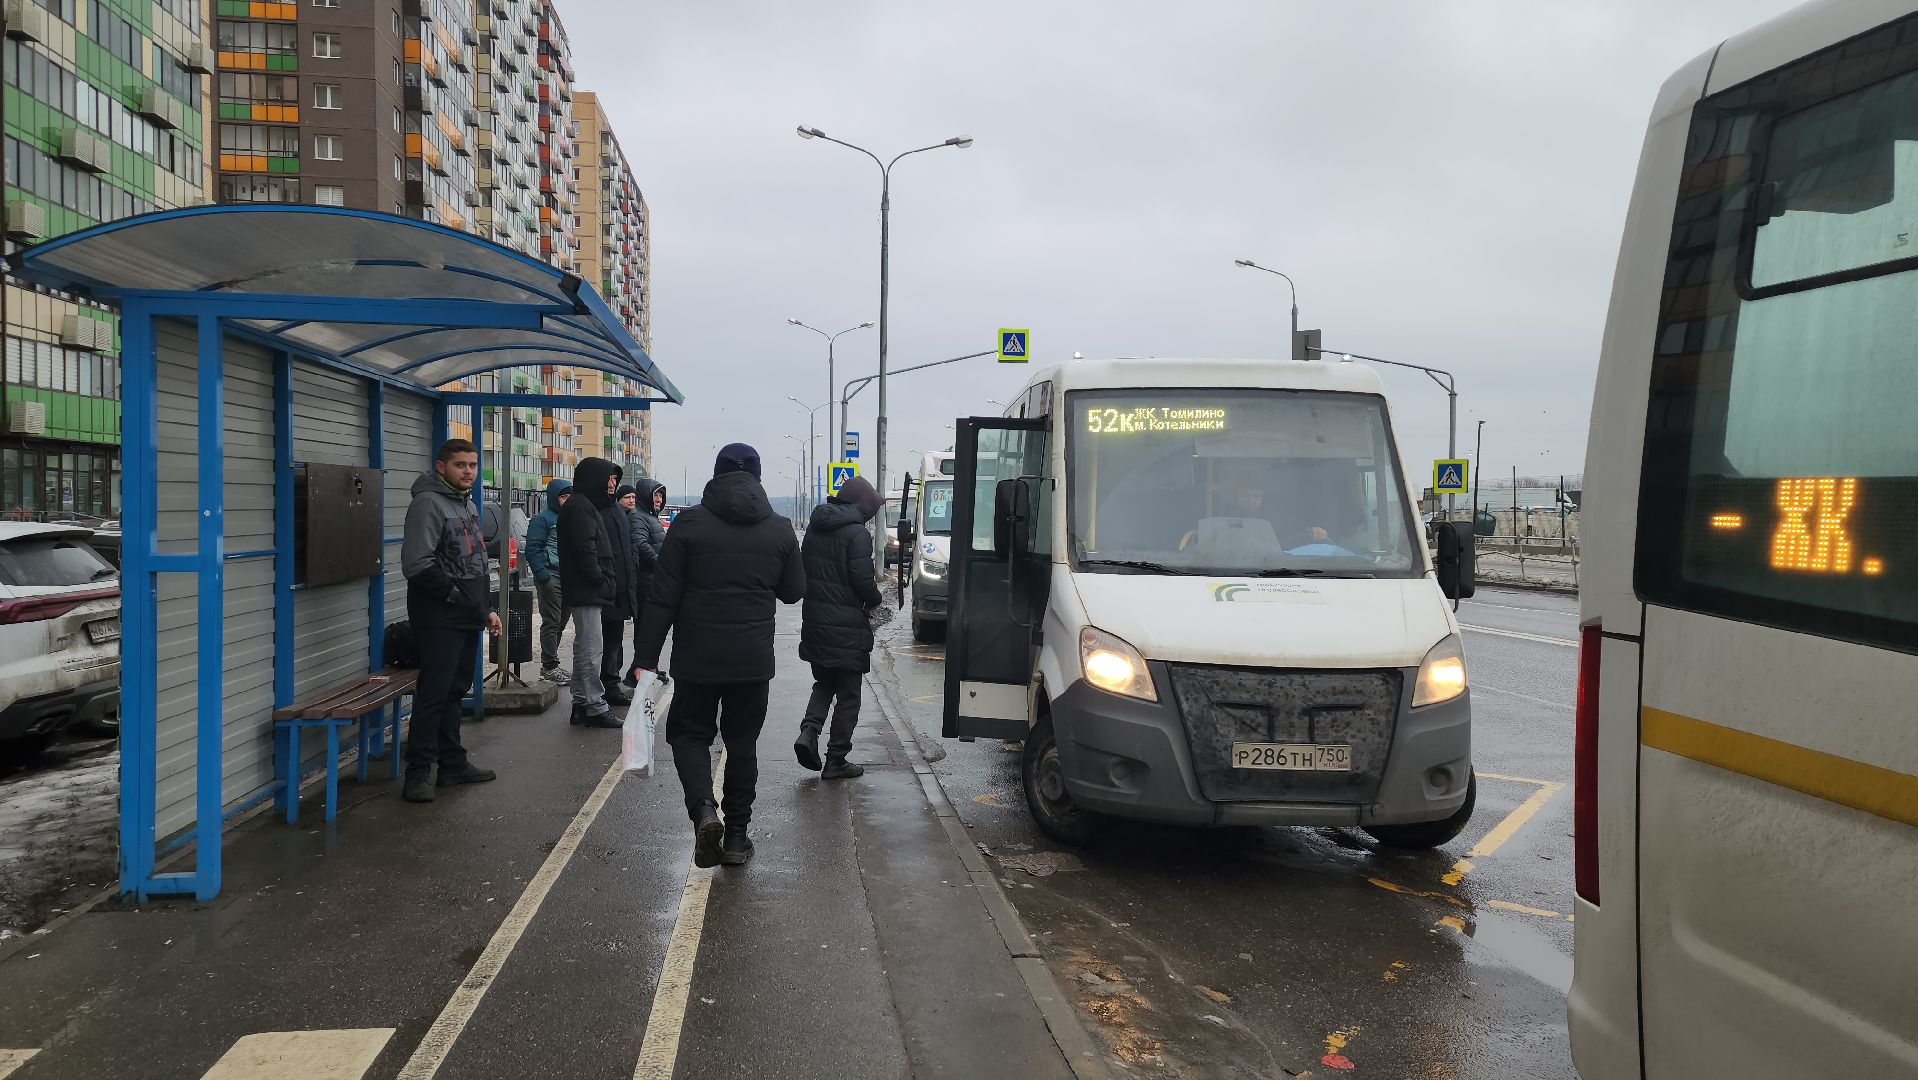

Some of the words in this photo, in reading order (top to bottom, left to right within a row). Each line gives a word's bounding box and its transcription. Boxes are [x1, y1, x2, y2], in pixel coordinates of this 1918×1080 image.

[1135, 407, 1156, 419] ЖК
[1161, 407, 1225, 419] Томилино
[1134, 420, 1147, 431] м.
[1149, 419, 1224, 431] Котельники
[1317, 747, 1345, 763] 750
